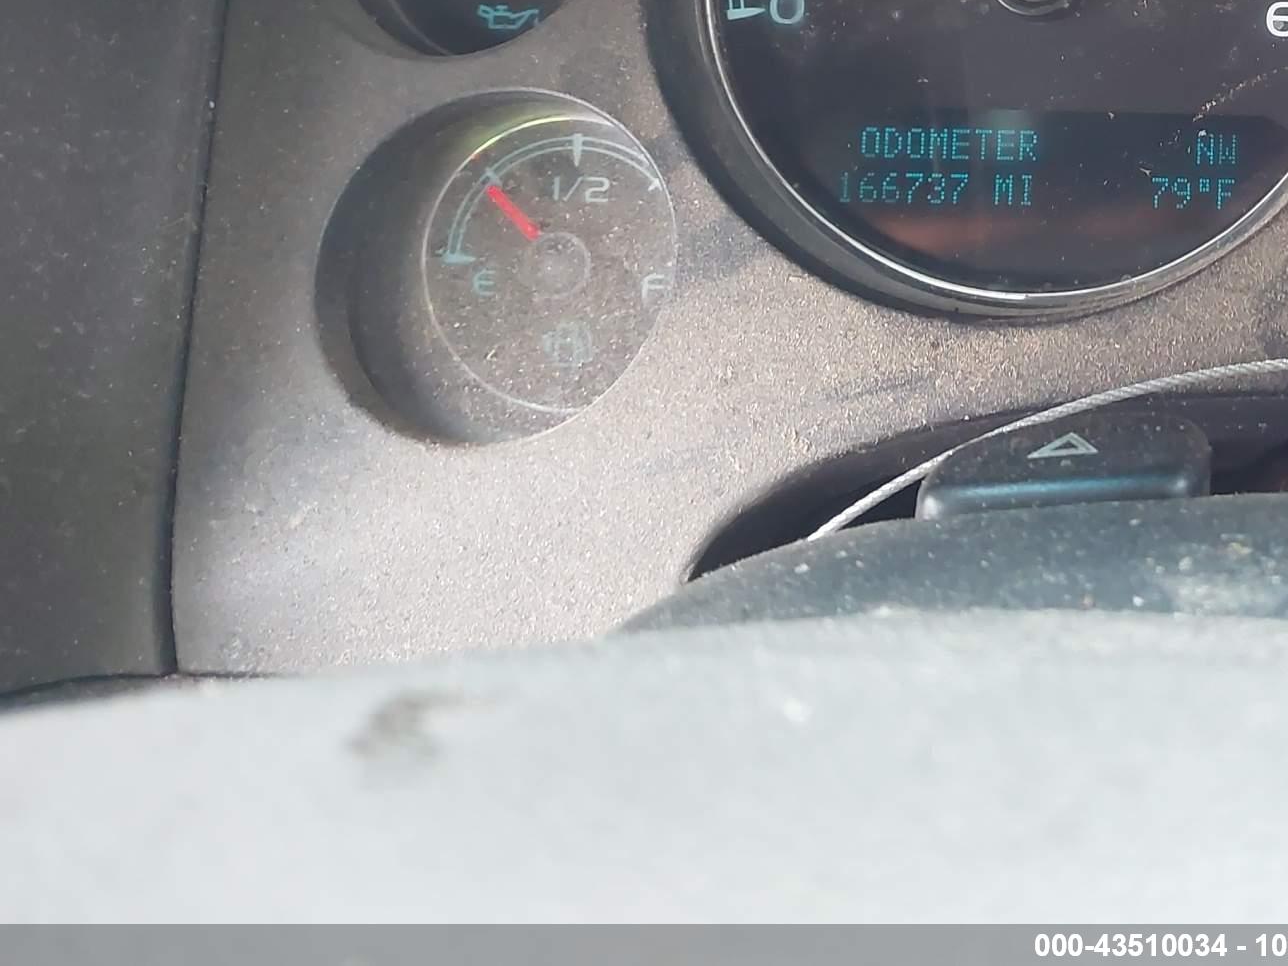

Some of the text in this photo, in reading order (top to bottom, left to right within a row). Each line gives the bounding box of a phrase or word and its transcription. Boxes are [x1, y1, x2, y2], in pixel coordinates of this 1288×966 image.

[861, 126, 1038, 162] ODOMETER
[1196, 133, 1236, 166] NW
[553, 176, 611, 203] 1/2
[840, 172, 1033, 206] 166737 MI
[1151, 176, 1236, 210] 79°F
